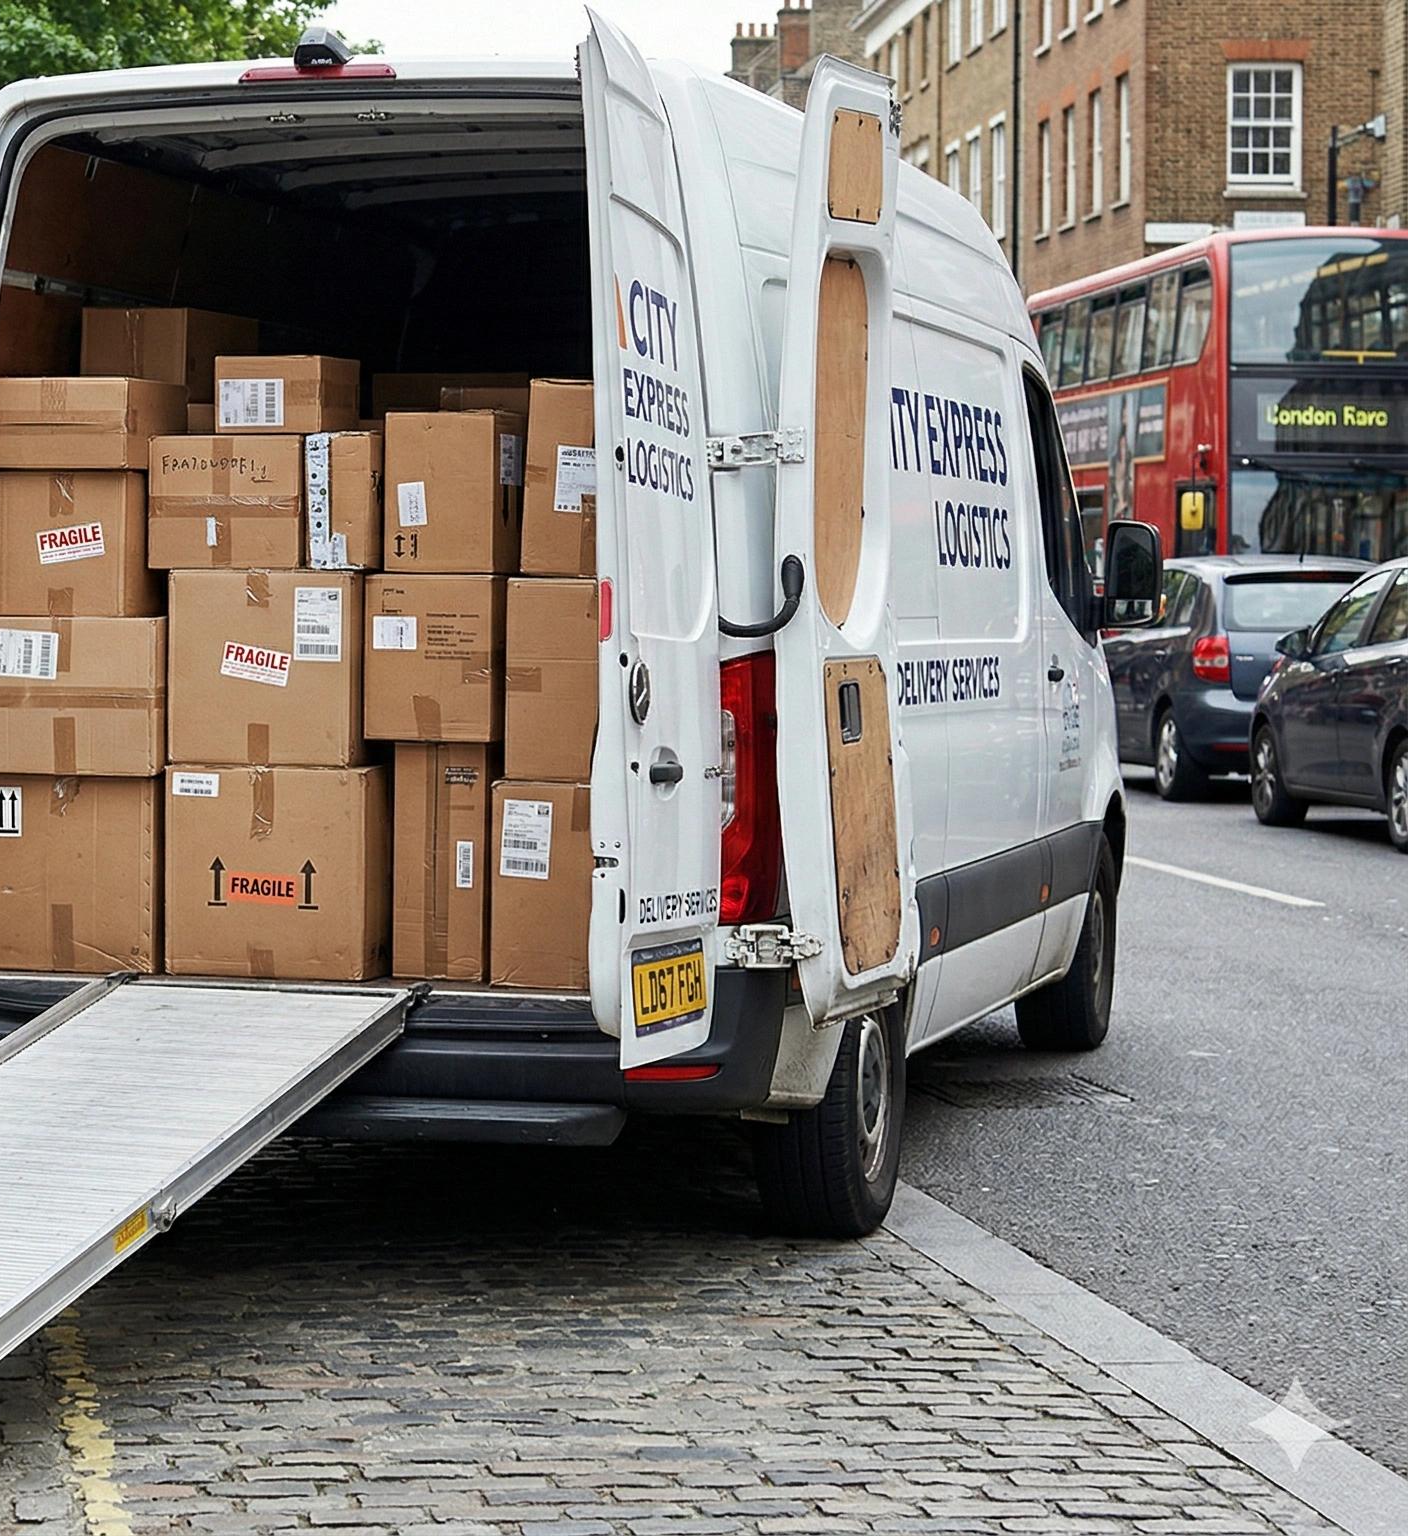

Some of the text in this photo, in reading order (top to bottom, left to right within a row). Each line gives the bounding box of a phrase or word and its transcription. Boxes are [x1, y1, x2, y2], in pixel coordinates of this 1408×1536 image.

[629, 279, 678, 372] CITY
[623, 367, 690, 438] EXPRESS
[890, 387, 921, 473] ITY
[924, 394, 1008, 487] EXPRESS
[626, 437, 694, 503] LOGISTICS
[39, 525, 101, 550] FRAGILE
[935, 499, 1011, 570] LOGISTICS
[225, 644, 289, 671] FRAGILE
[897, 656, 1000, 706] DELIVERY SERVICES
[231, 877, 295, 898] FRAGILE
[639, 893, 684, 924] DELIVERY
[639, 965, 675, 1016] LD67
